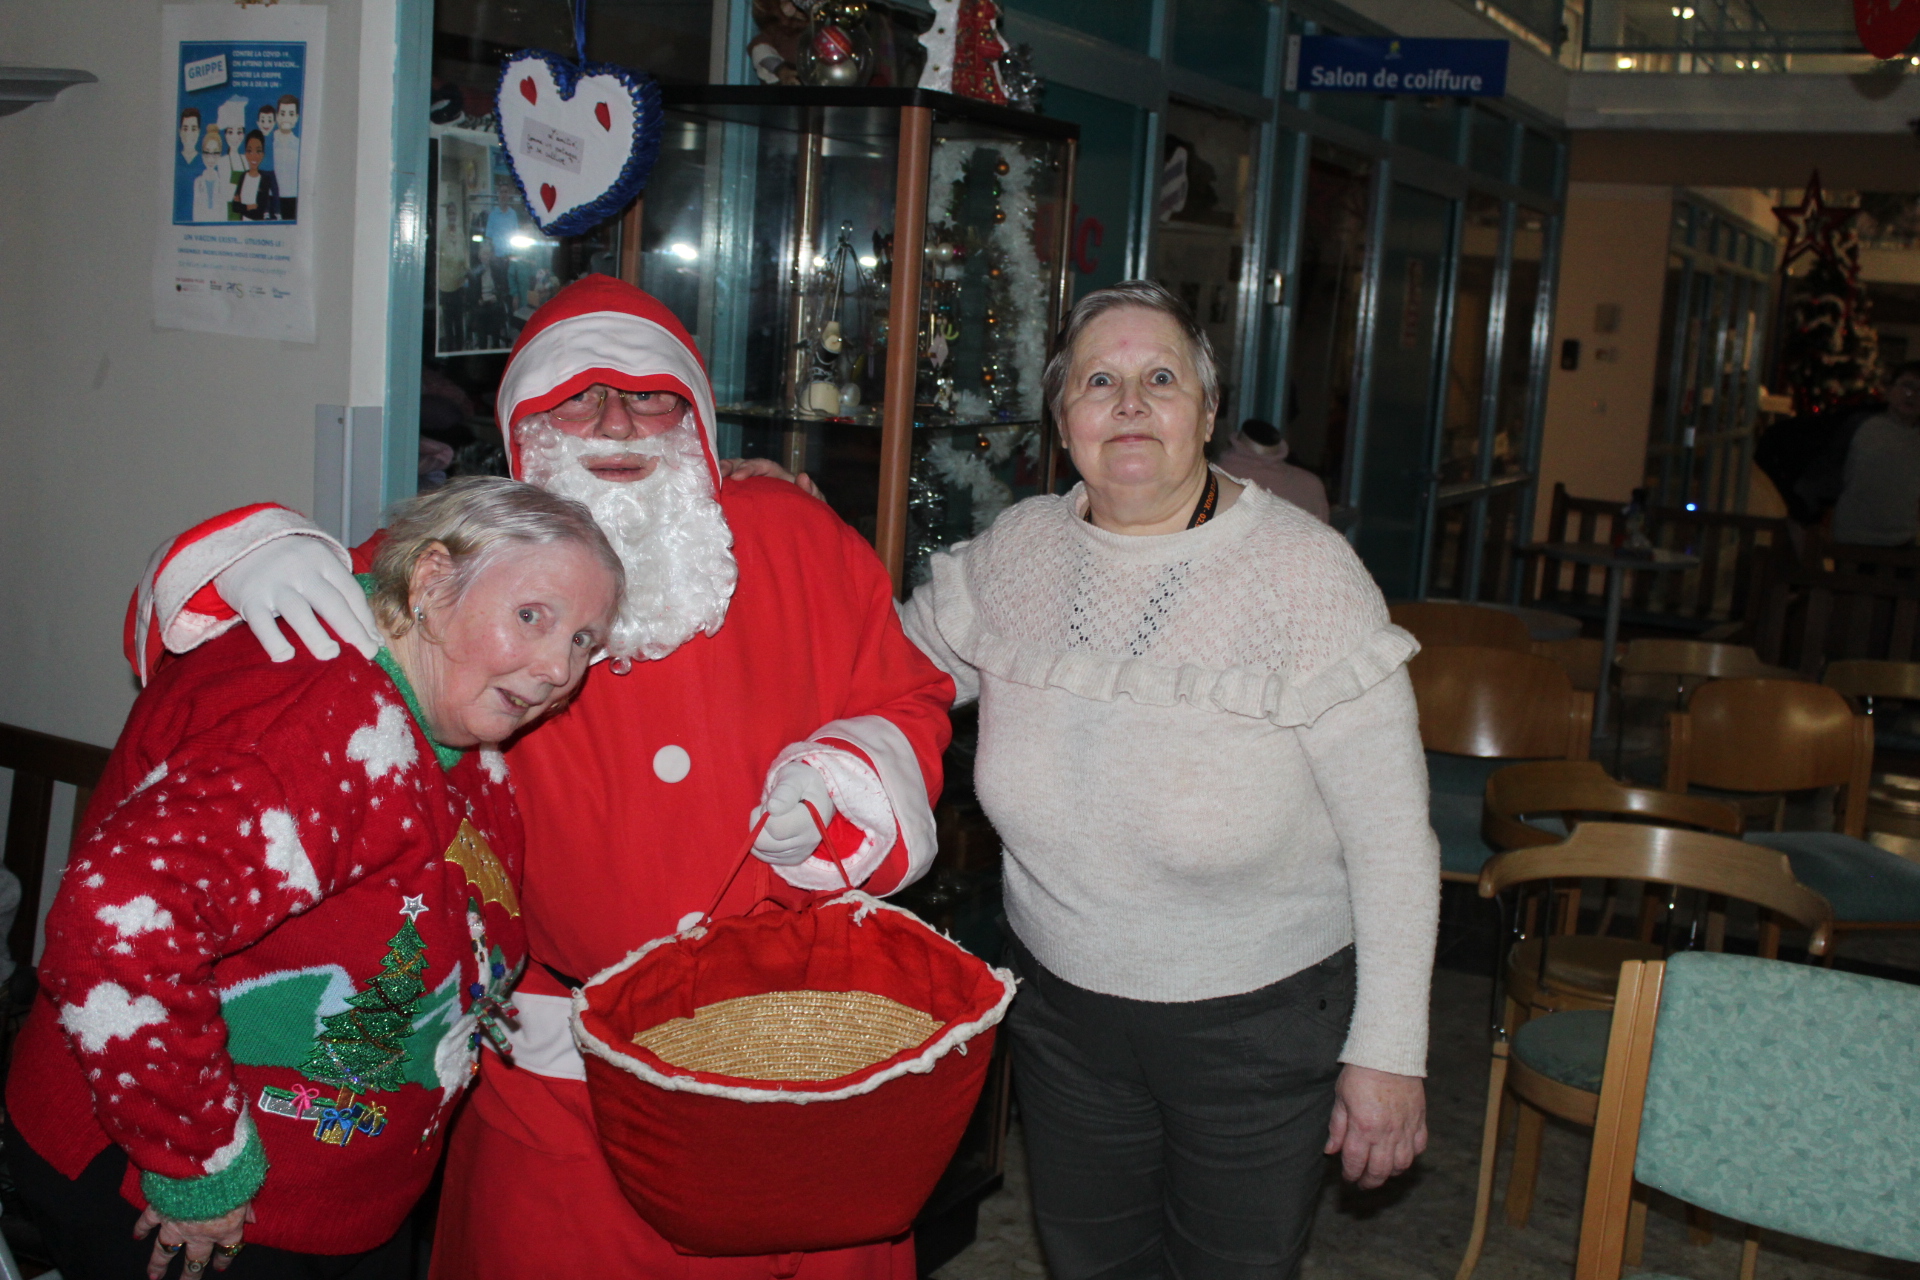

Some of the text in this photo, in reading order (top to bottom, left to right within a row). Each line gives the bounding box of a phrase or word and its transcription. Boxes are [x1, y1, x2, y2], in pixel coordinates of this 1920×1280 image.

[188, 60, 223, 79] GRIPPE
[1311, 66, 1482, 91] Salon de coiffure
